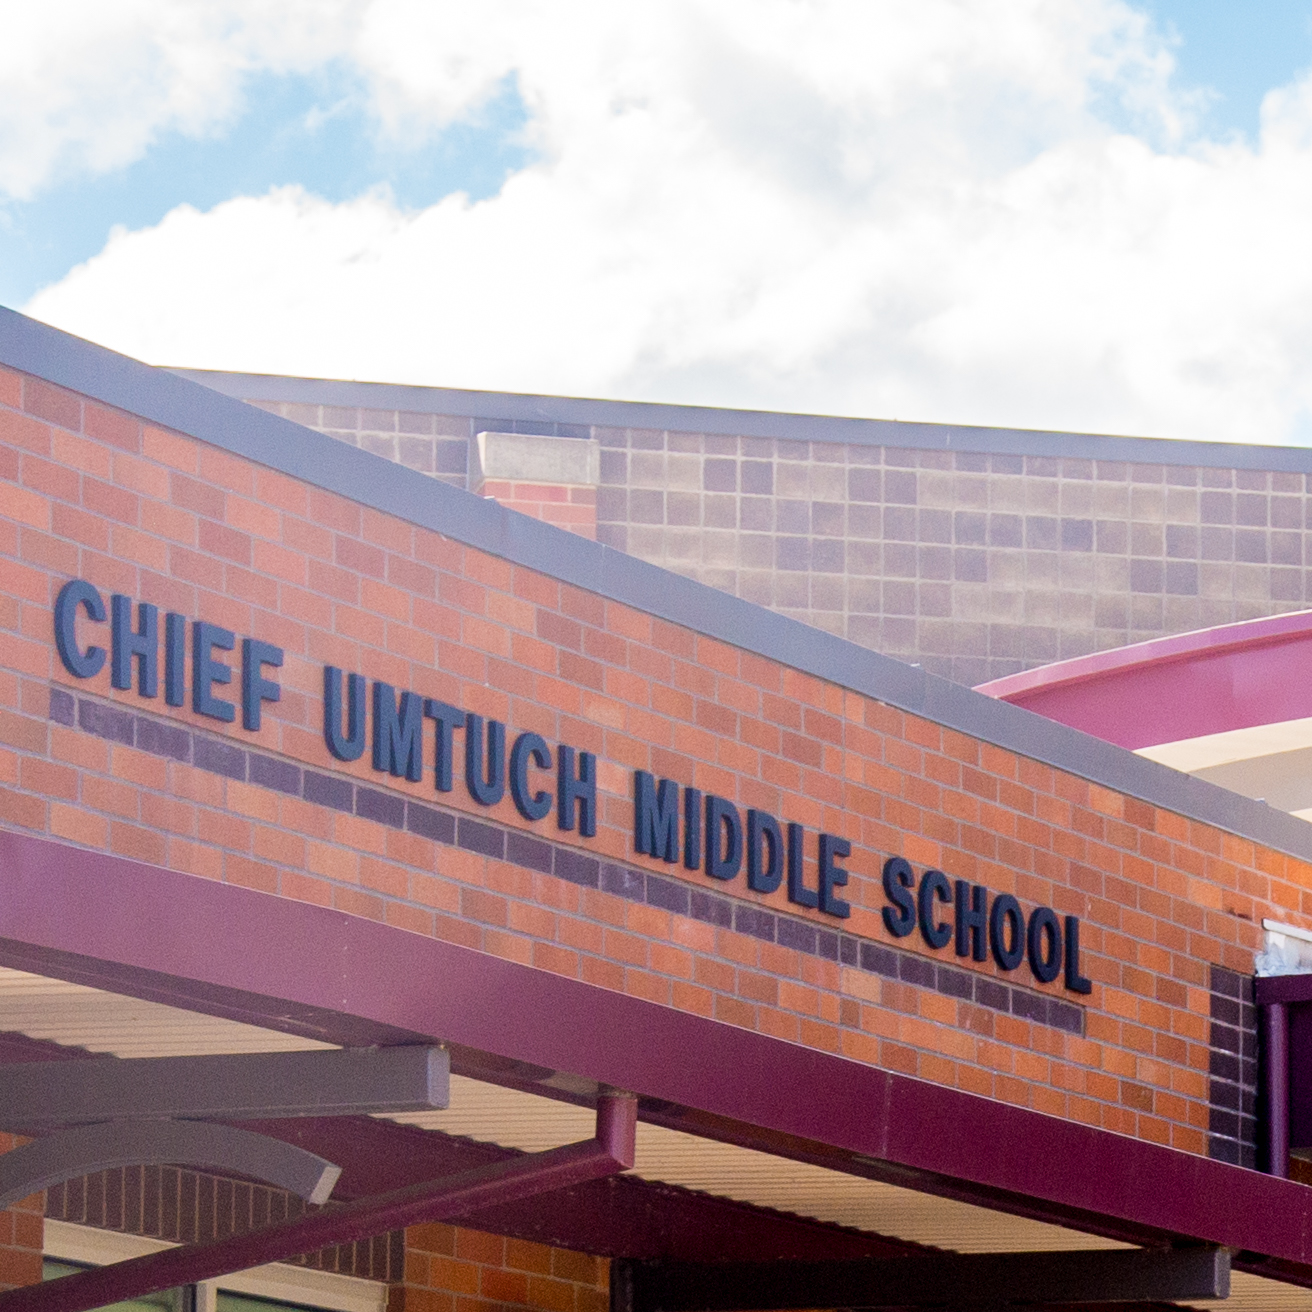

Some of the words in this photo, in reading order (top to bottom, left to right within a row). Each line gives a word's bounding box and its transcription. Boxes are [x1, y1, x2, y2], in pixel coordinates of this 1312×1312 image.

[54, 578, 285, 732] CHIEF
[323, 664, 598, 838] UMTUCH
[634, 769, 852, 920] MIDDLE
[881, 856, 1093, 996] SCHOOL
